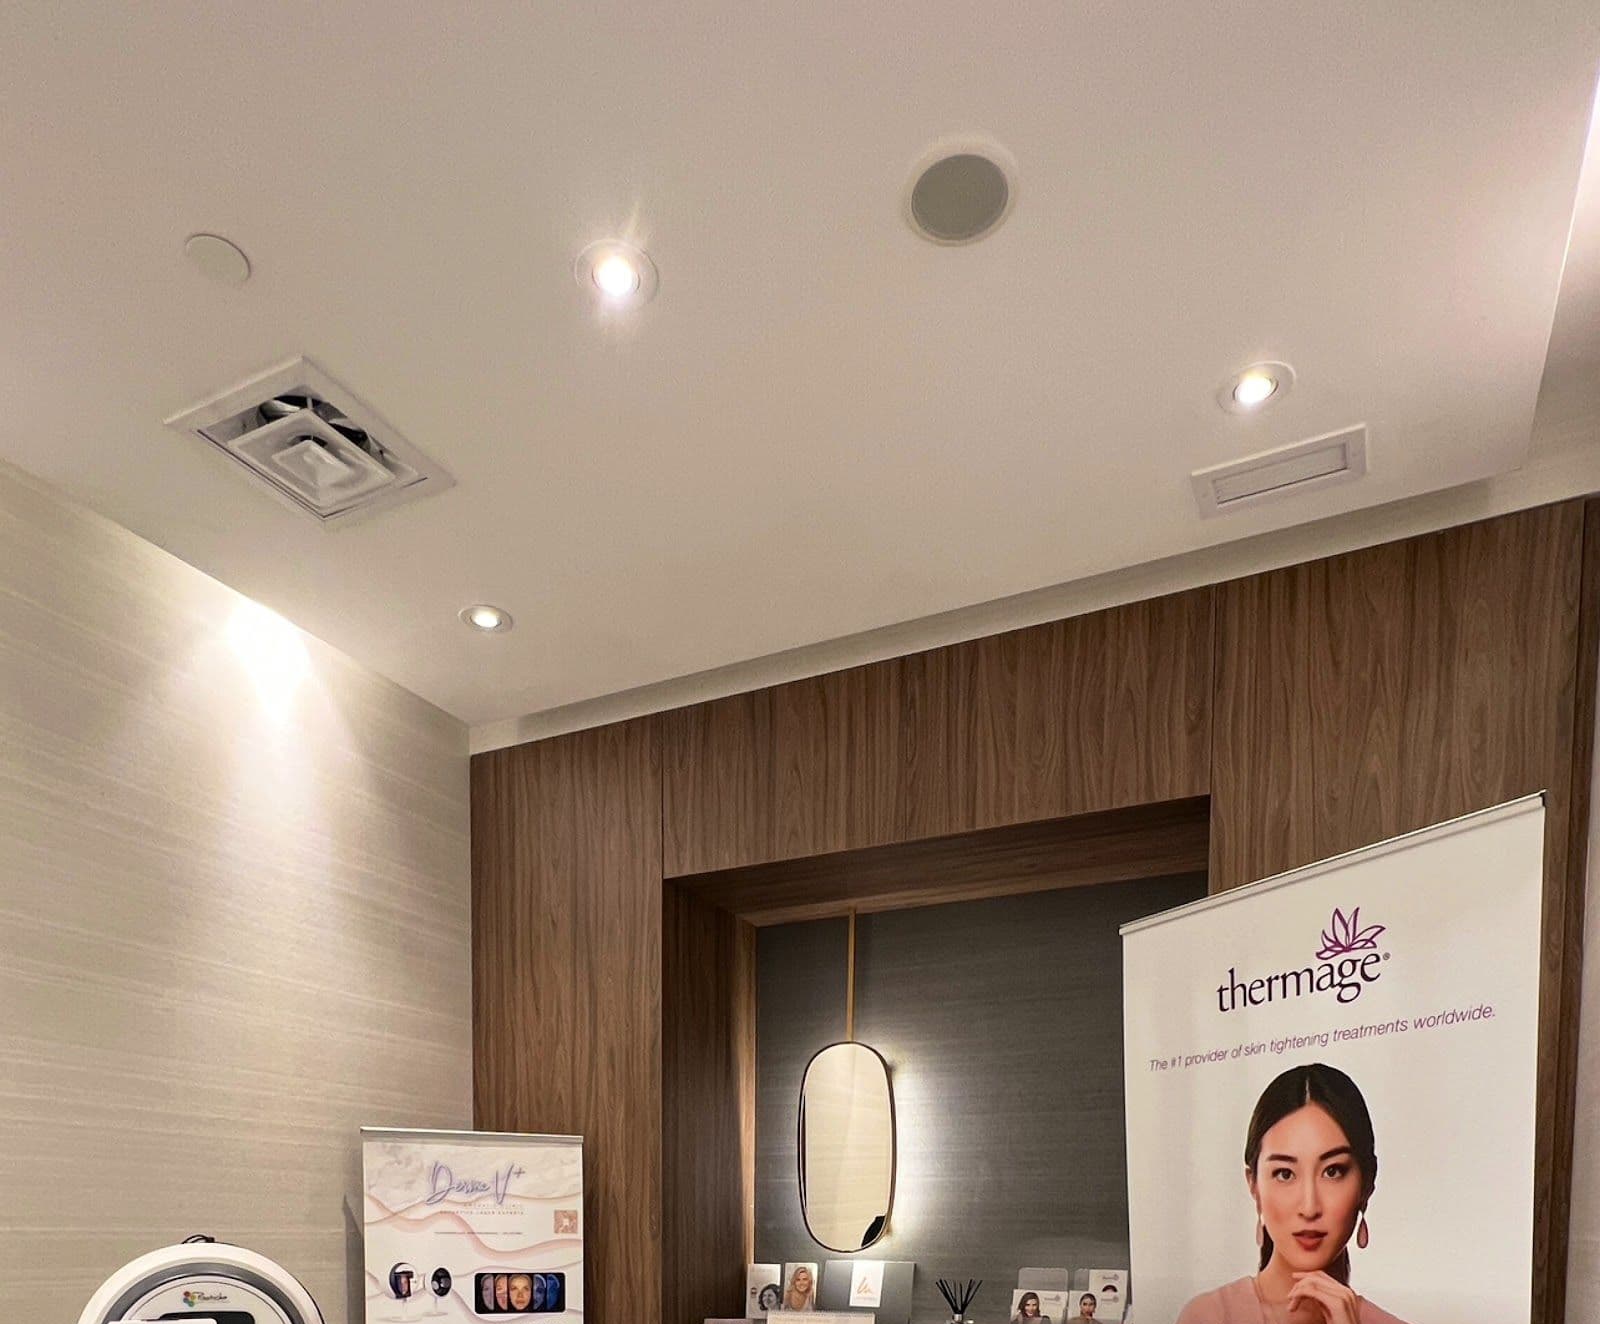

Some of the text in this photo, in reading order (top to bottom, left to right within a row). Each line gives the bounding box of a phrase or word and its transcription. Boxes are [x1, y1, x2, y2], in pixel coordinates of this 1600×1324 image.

[1217, 953, 1382, 1012] thermage
[1150, 1003, 1496, 1071] The #1 provider of skin tightening treatments worldwide.
